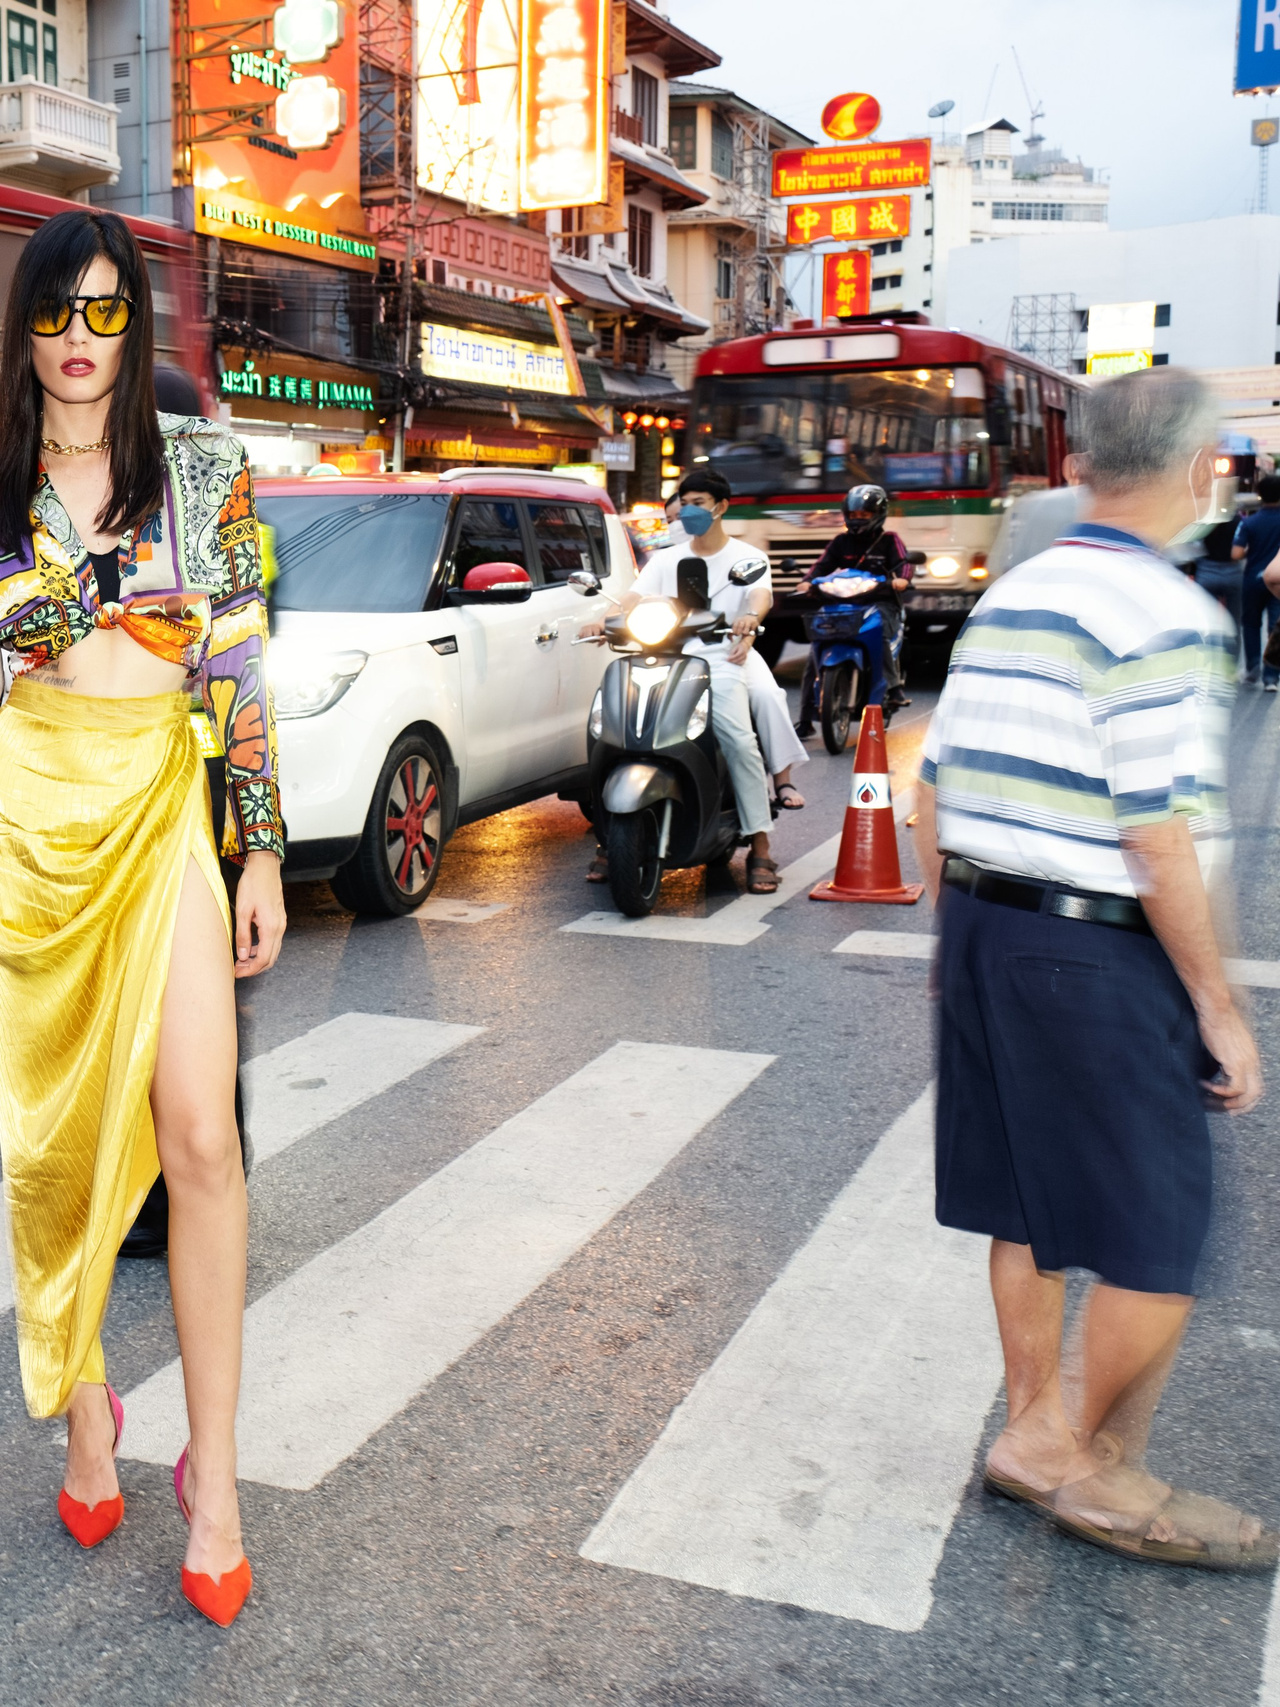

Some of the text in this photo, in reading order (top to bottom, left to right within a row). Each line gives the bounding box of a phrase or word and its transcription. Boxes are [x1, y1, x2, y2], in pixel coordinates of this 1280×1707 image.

[204, 202, 231, 222] BIRD
[234, 211, 261, 230] NEST
[263, 218, 273, 234] &
[274, 221, 317, 245] DESSERT
[319, 233, 376, 260] RESTAURANT
[794, 201, 899, 241] 中國城
